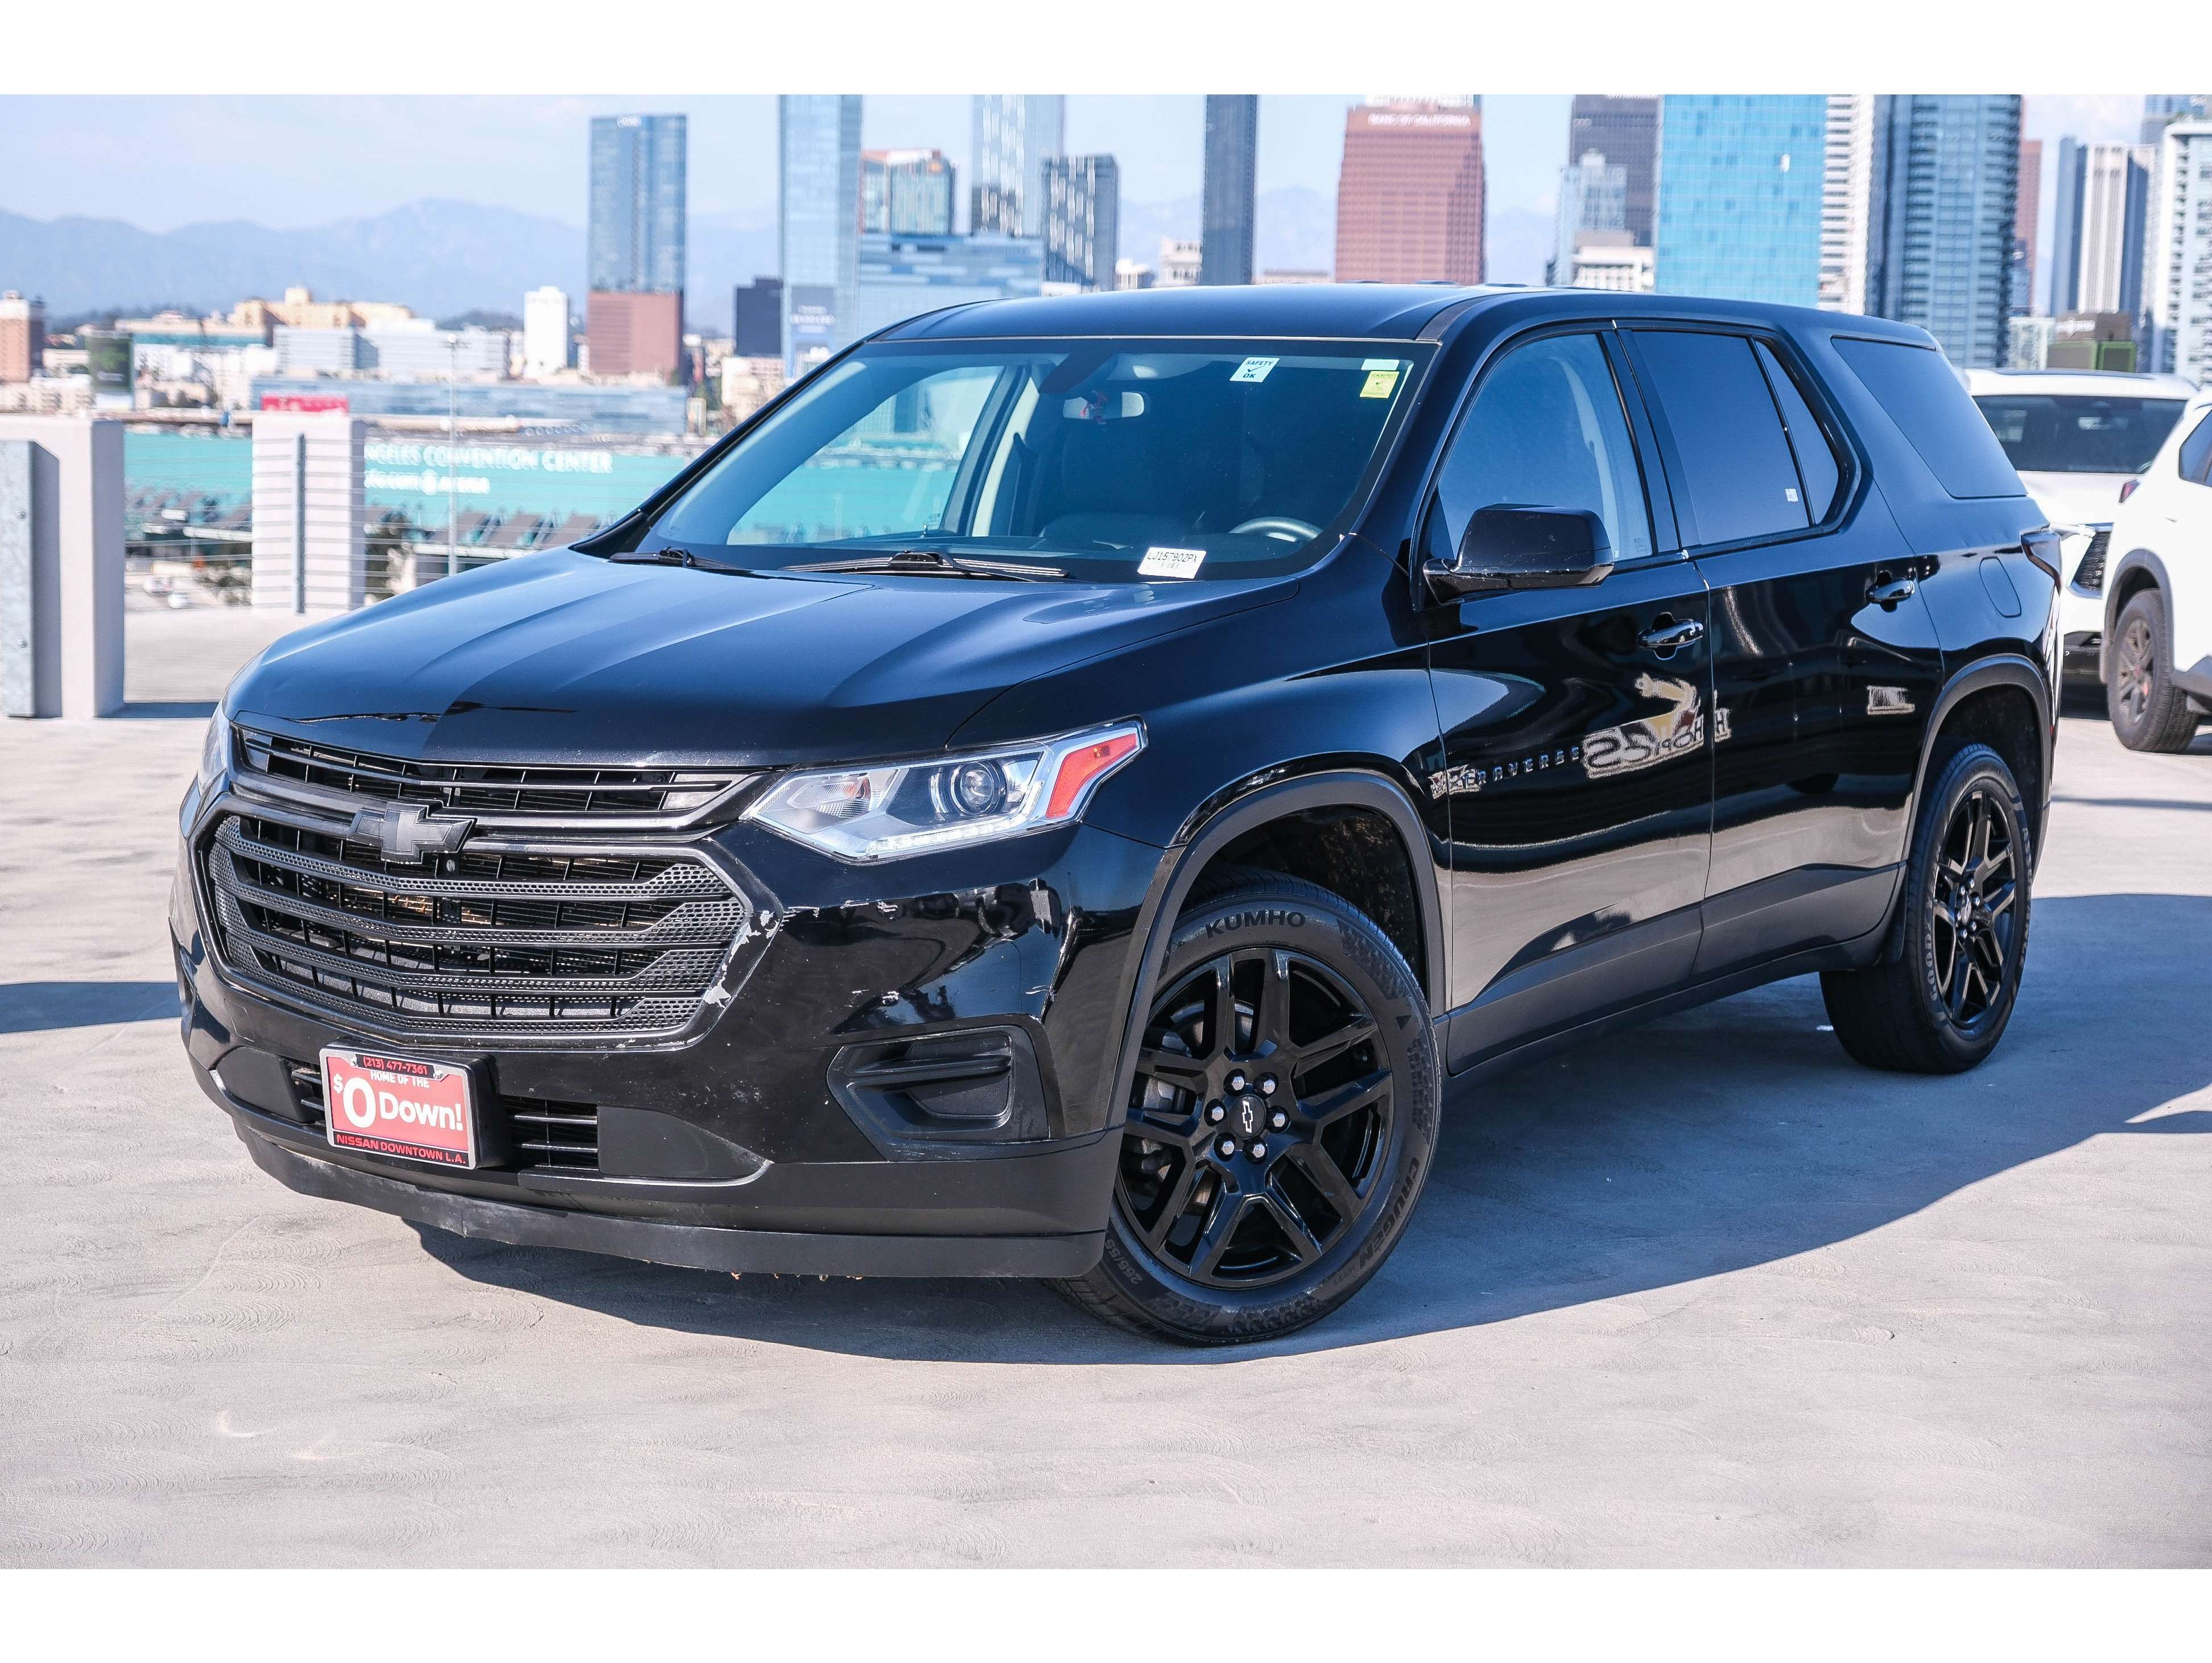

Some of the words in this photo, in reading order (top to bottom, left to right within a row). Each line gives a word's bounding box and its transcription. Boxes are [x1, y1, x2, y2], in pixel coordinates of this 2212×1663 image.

[364, 444, 421, 466] NGELES
[423, 445, 539, 471] CONVENTION
[541, 450, 613, 474] CENTER
[1461, 746, 1579, 789] TRAVERSE
[1204, 909, 1306, 939] KUMHO
[363, 1056, 385, 1069] (213)
[386, 1059, 428, 1075] 477-7361
[370, 1070, 396, 1084] HOME
[397, 1074, 408, 1086] OF
[411, 1076, 430, 1088] THE
[378, 1091, 464, 1131] Down!
[336, 1134, 379, 1150] NISSAN
[380, 1141, 443, 1160] DOWNTOWN
[445, 1153, 466, 1165] L.A.
